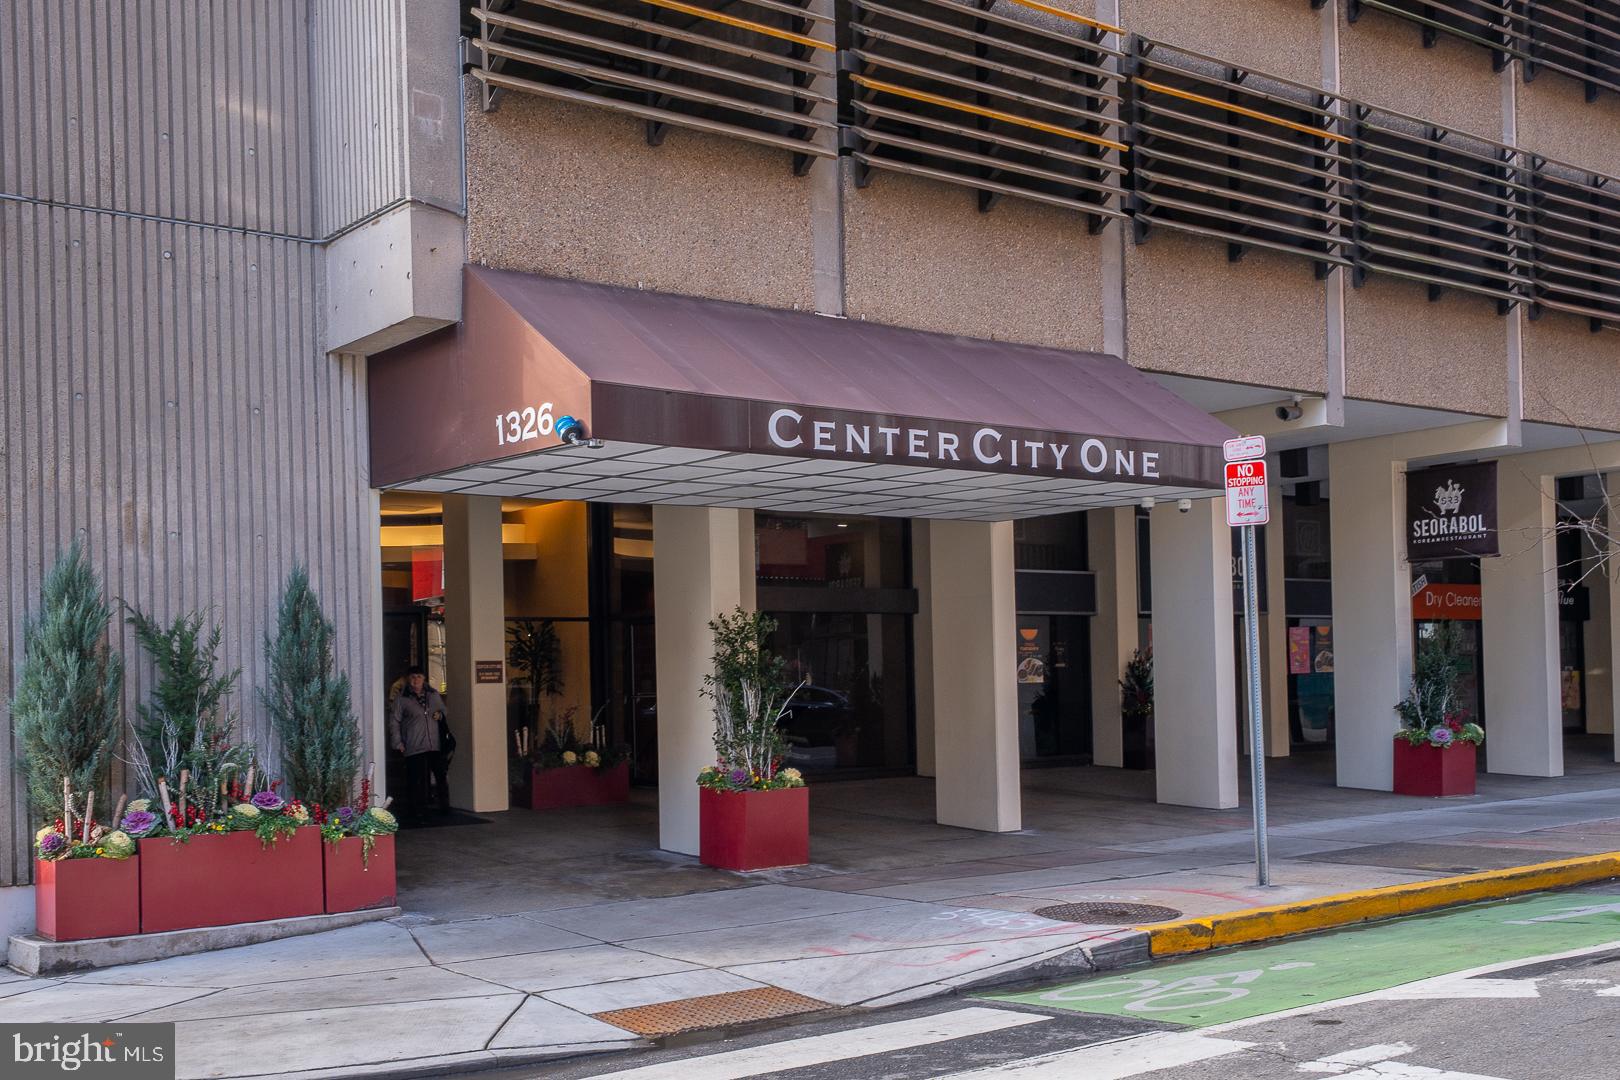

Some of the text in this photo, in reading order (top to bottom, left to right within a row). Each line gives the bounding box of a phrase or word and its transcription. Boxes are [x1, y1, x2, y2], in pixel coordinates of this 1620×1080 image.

[495, 402, 554, 446] 1326
[1237, 463, 1254, 477] NO
[1228, 475, 1264, 487] STOPPING
[1238, 486, 1255, 497] ANY
[1236, 498, 1256, 508] TIME
[1413, 514, 1487, 537] SEORABOL
[1426, 591, 1443, 607] Dry
